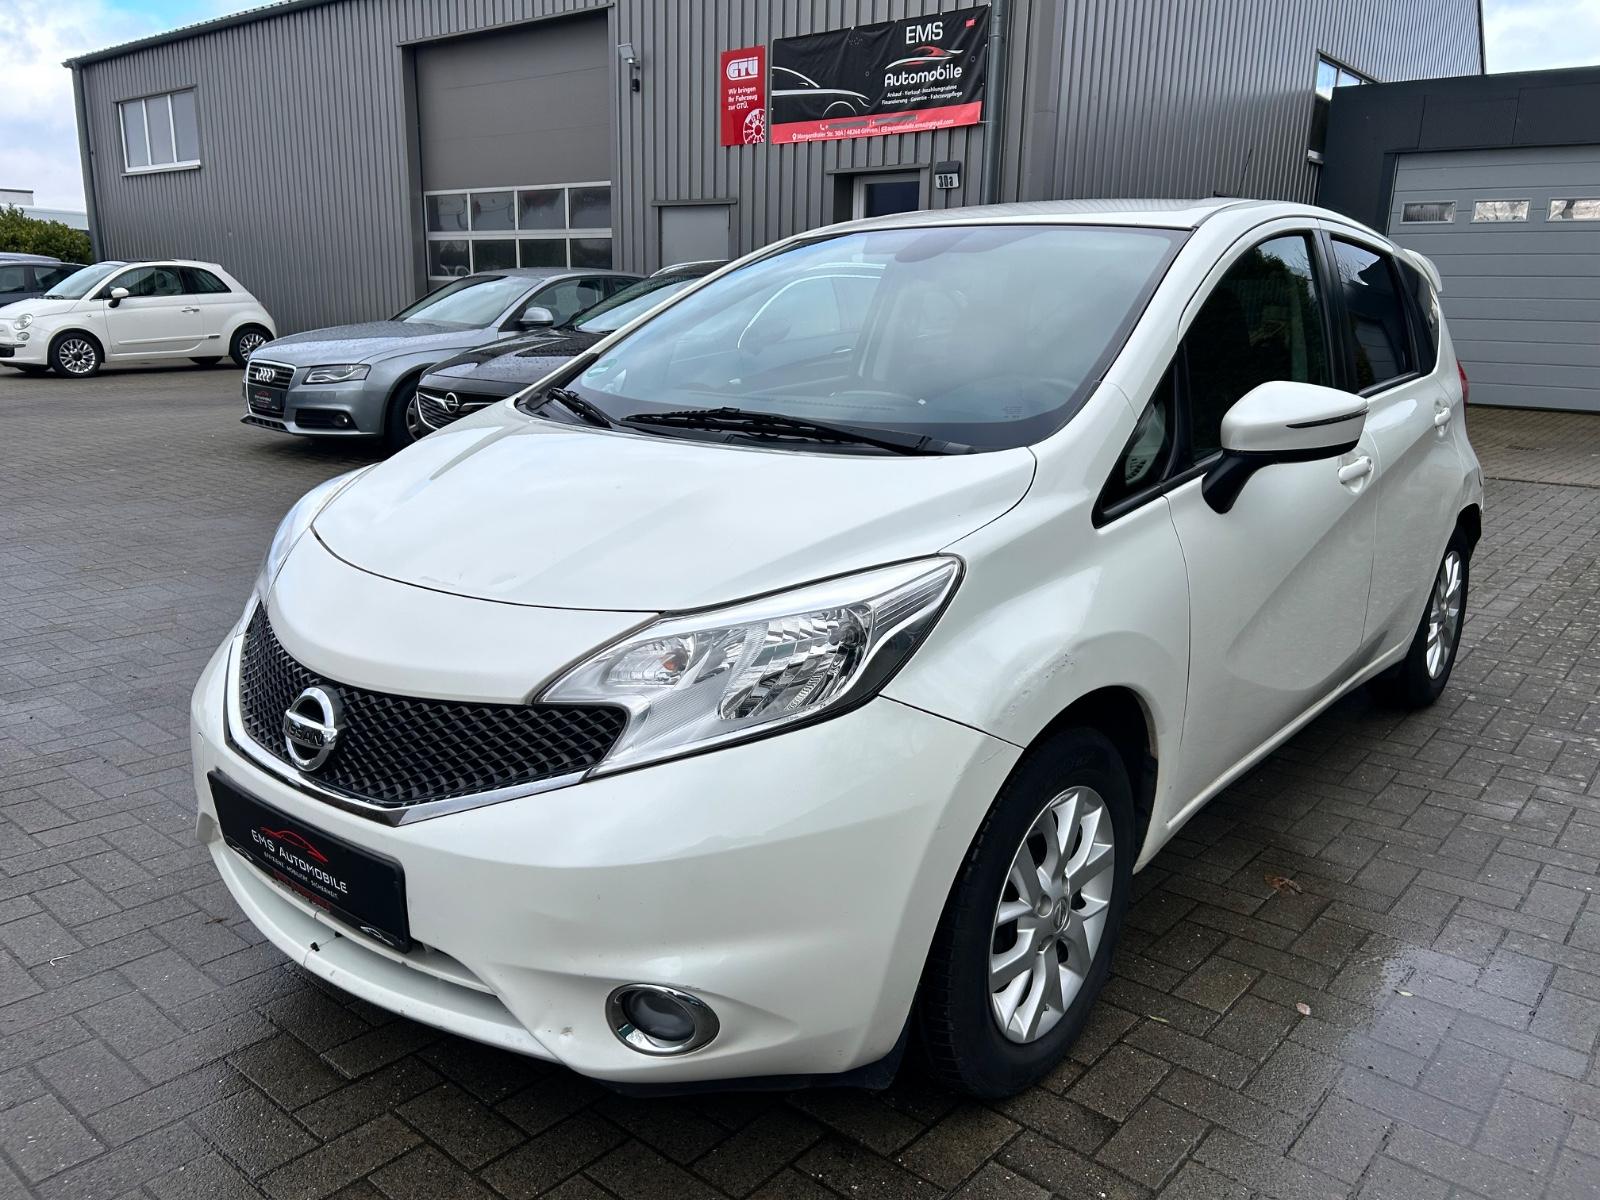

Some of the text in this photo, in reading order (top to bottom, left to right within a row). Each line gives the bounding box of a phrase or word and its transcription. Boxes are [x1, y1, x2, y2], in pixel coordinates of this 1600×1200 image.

[906, 21, 944, 45] EMS
[884, 64, 963, 88] Automobile
[735, 94, 758, 102] Fahrzeug
[737, 86, 757, 94] bringen
[931, 91, 963, 99] Fahrzeugpflege
[251, 829, 276, 853] EMS
